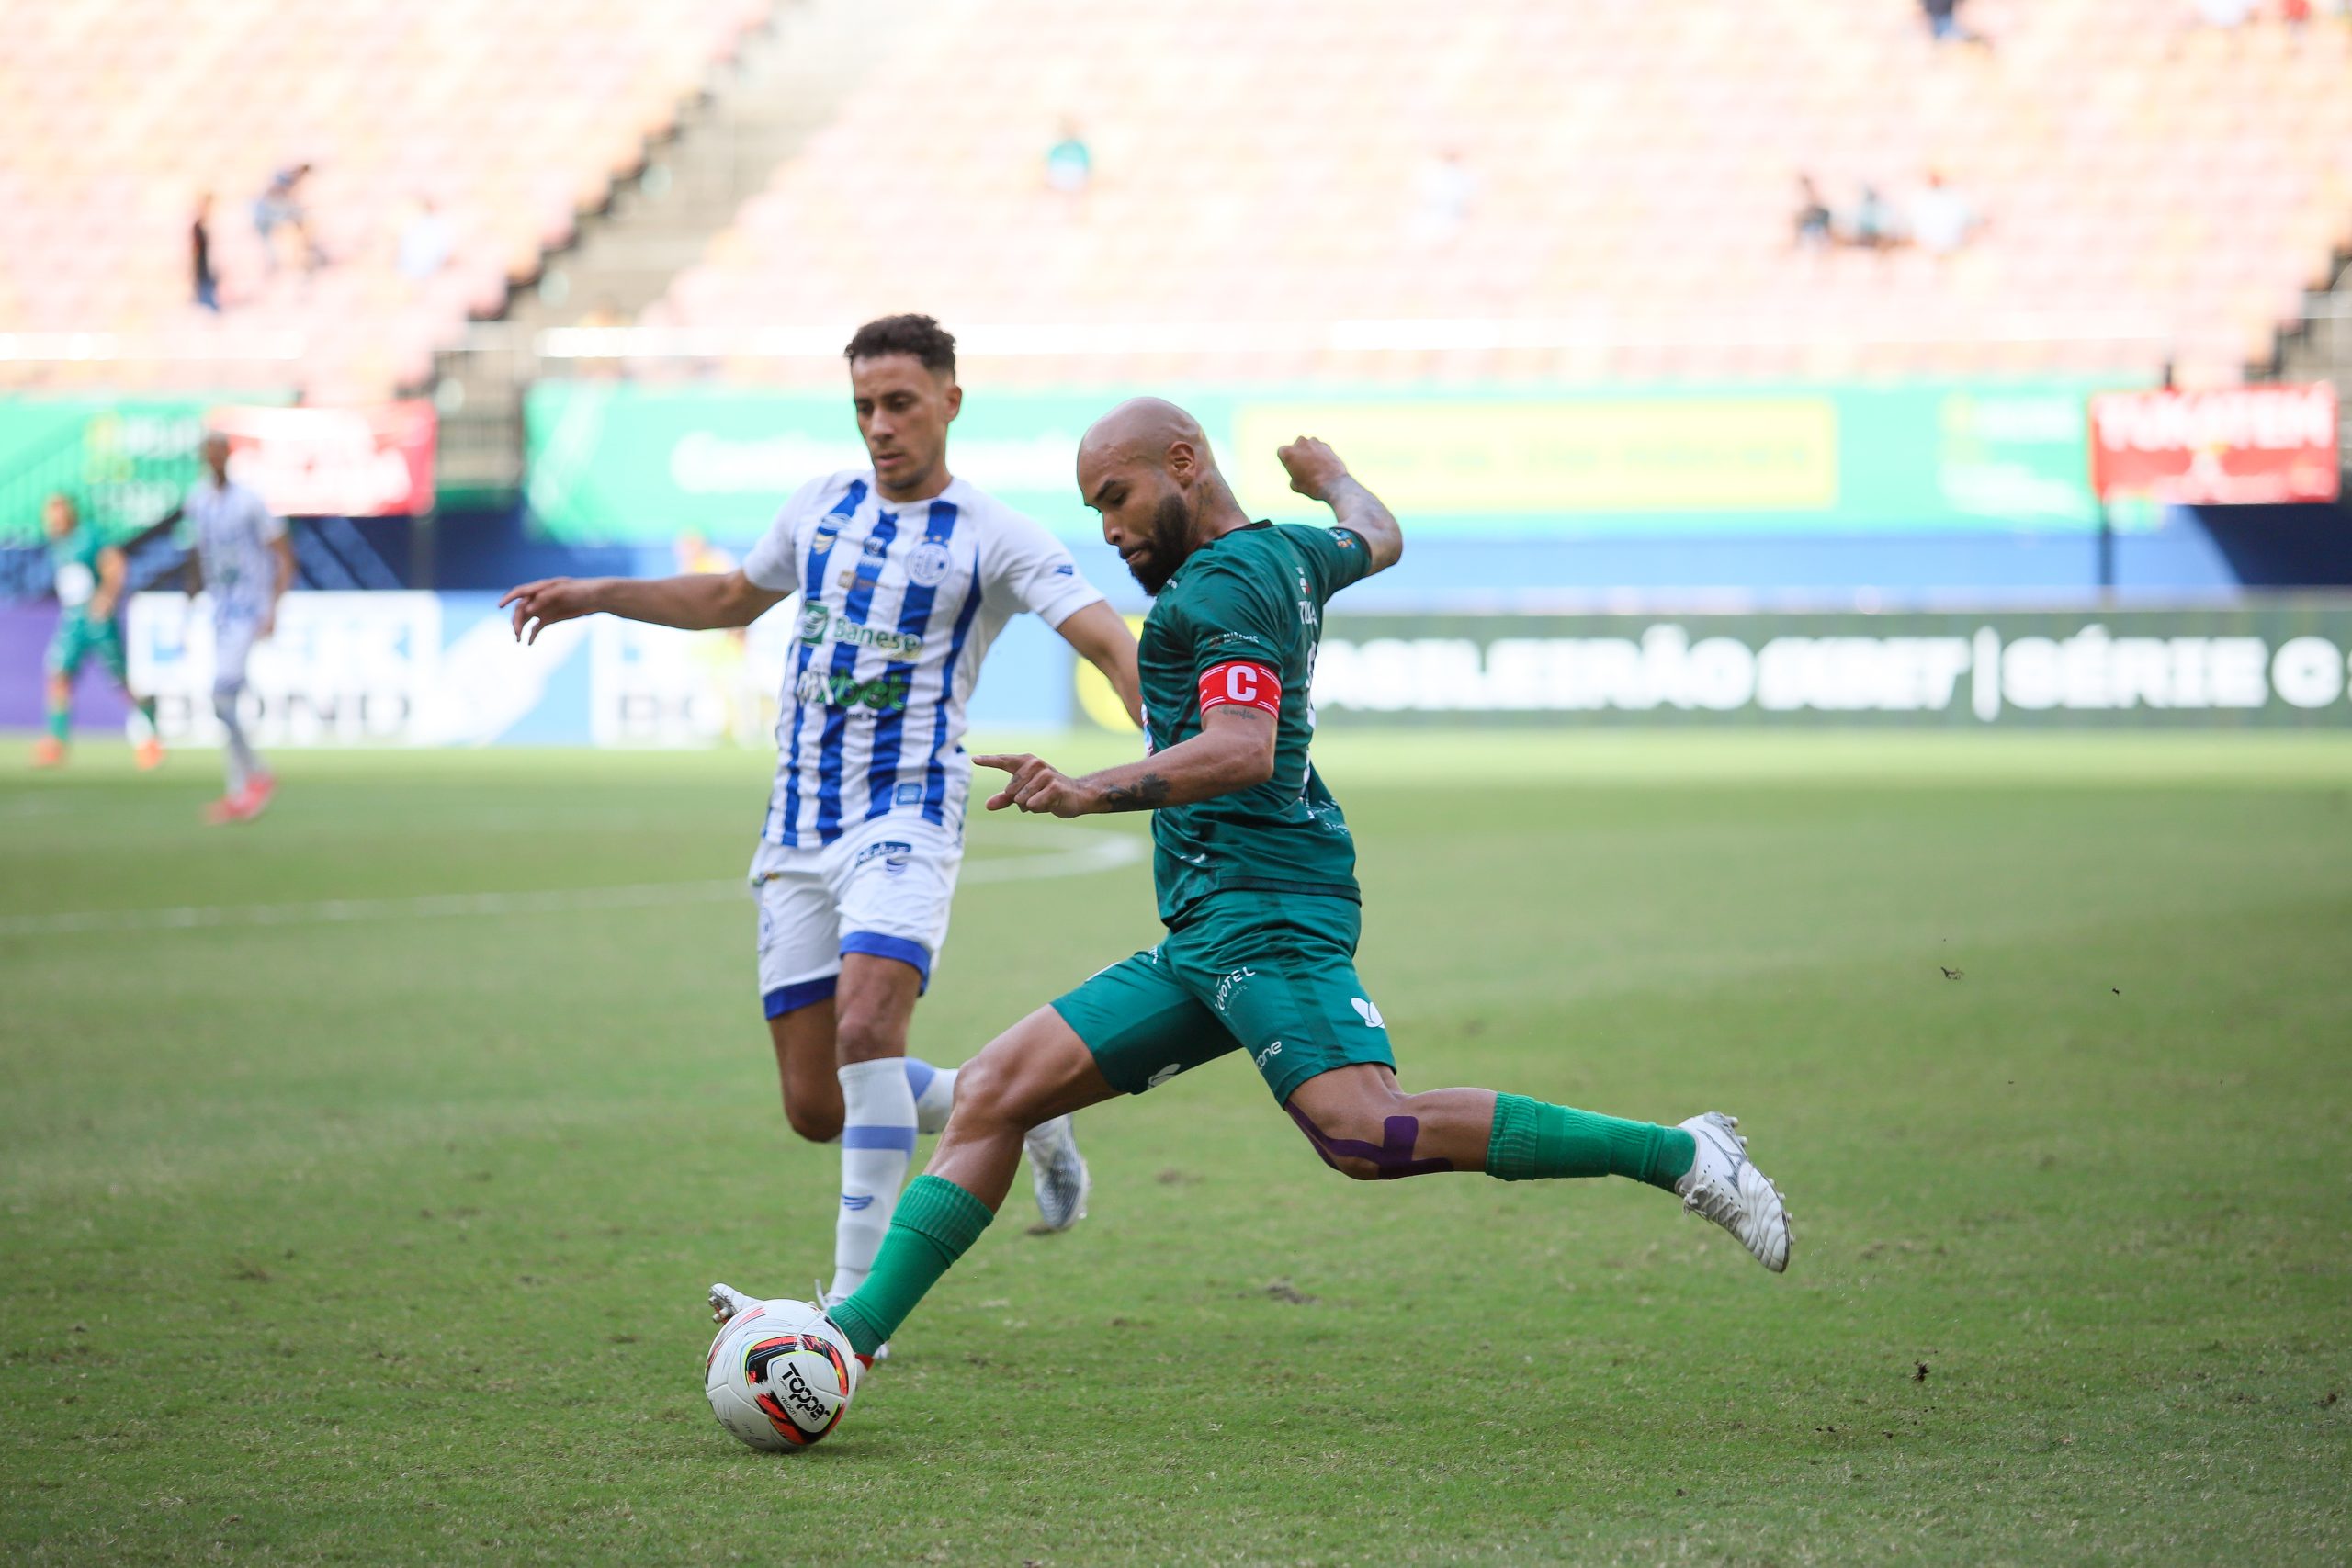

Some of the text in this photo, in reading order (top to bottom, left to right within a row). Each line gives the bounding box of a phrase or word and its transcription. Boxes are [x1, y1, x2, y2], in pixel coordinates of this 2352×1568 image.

[832, 615, 922, 651] Banese
[1227, 665, 1258, 702] C
[2001, 623, 2270, 710] SÉRIE
